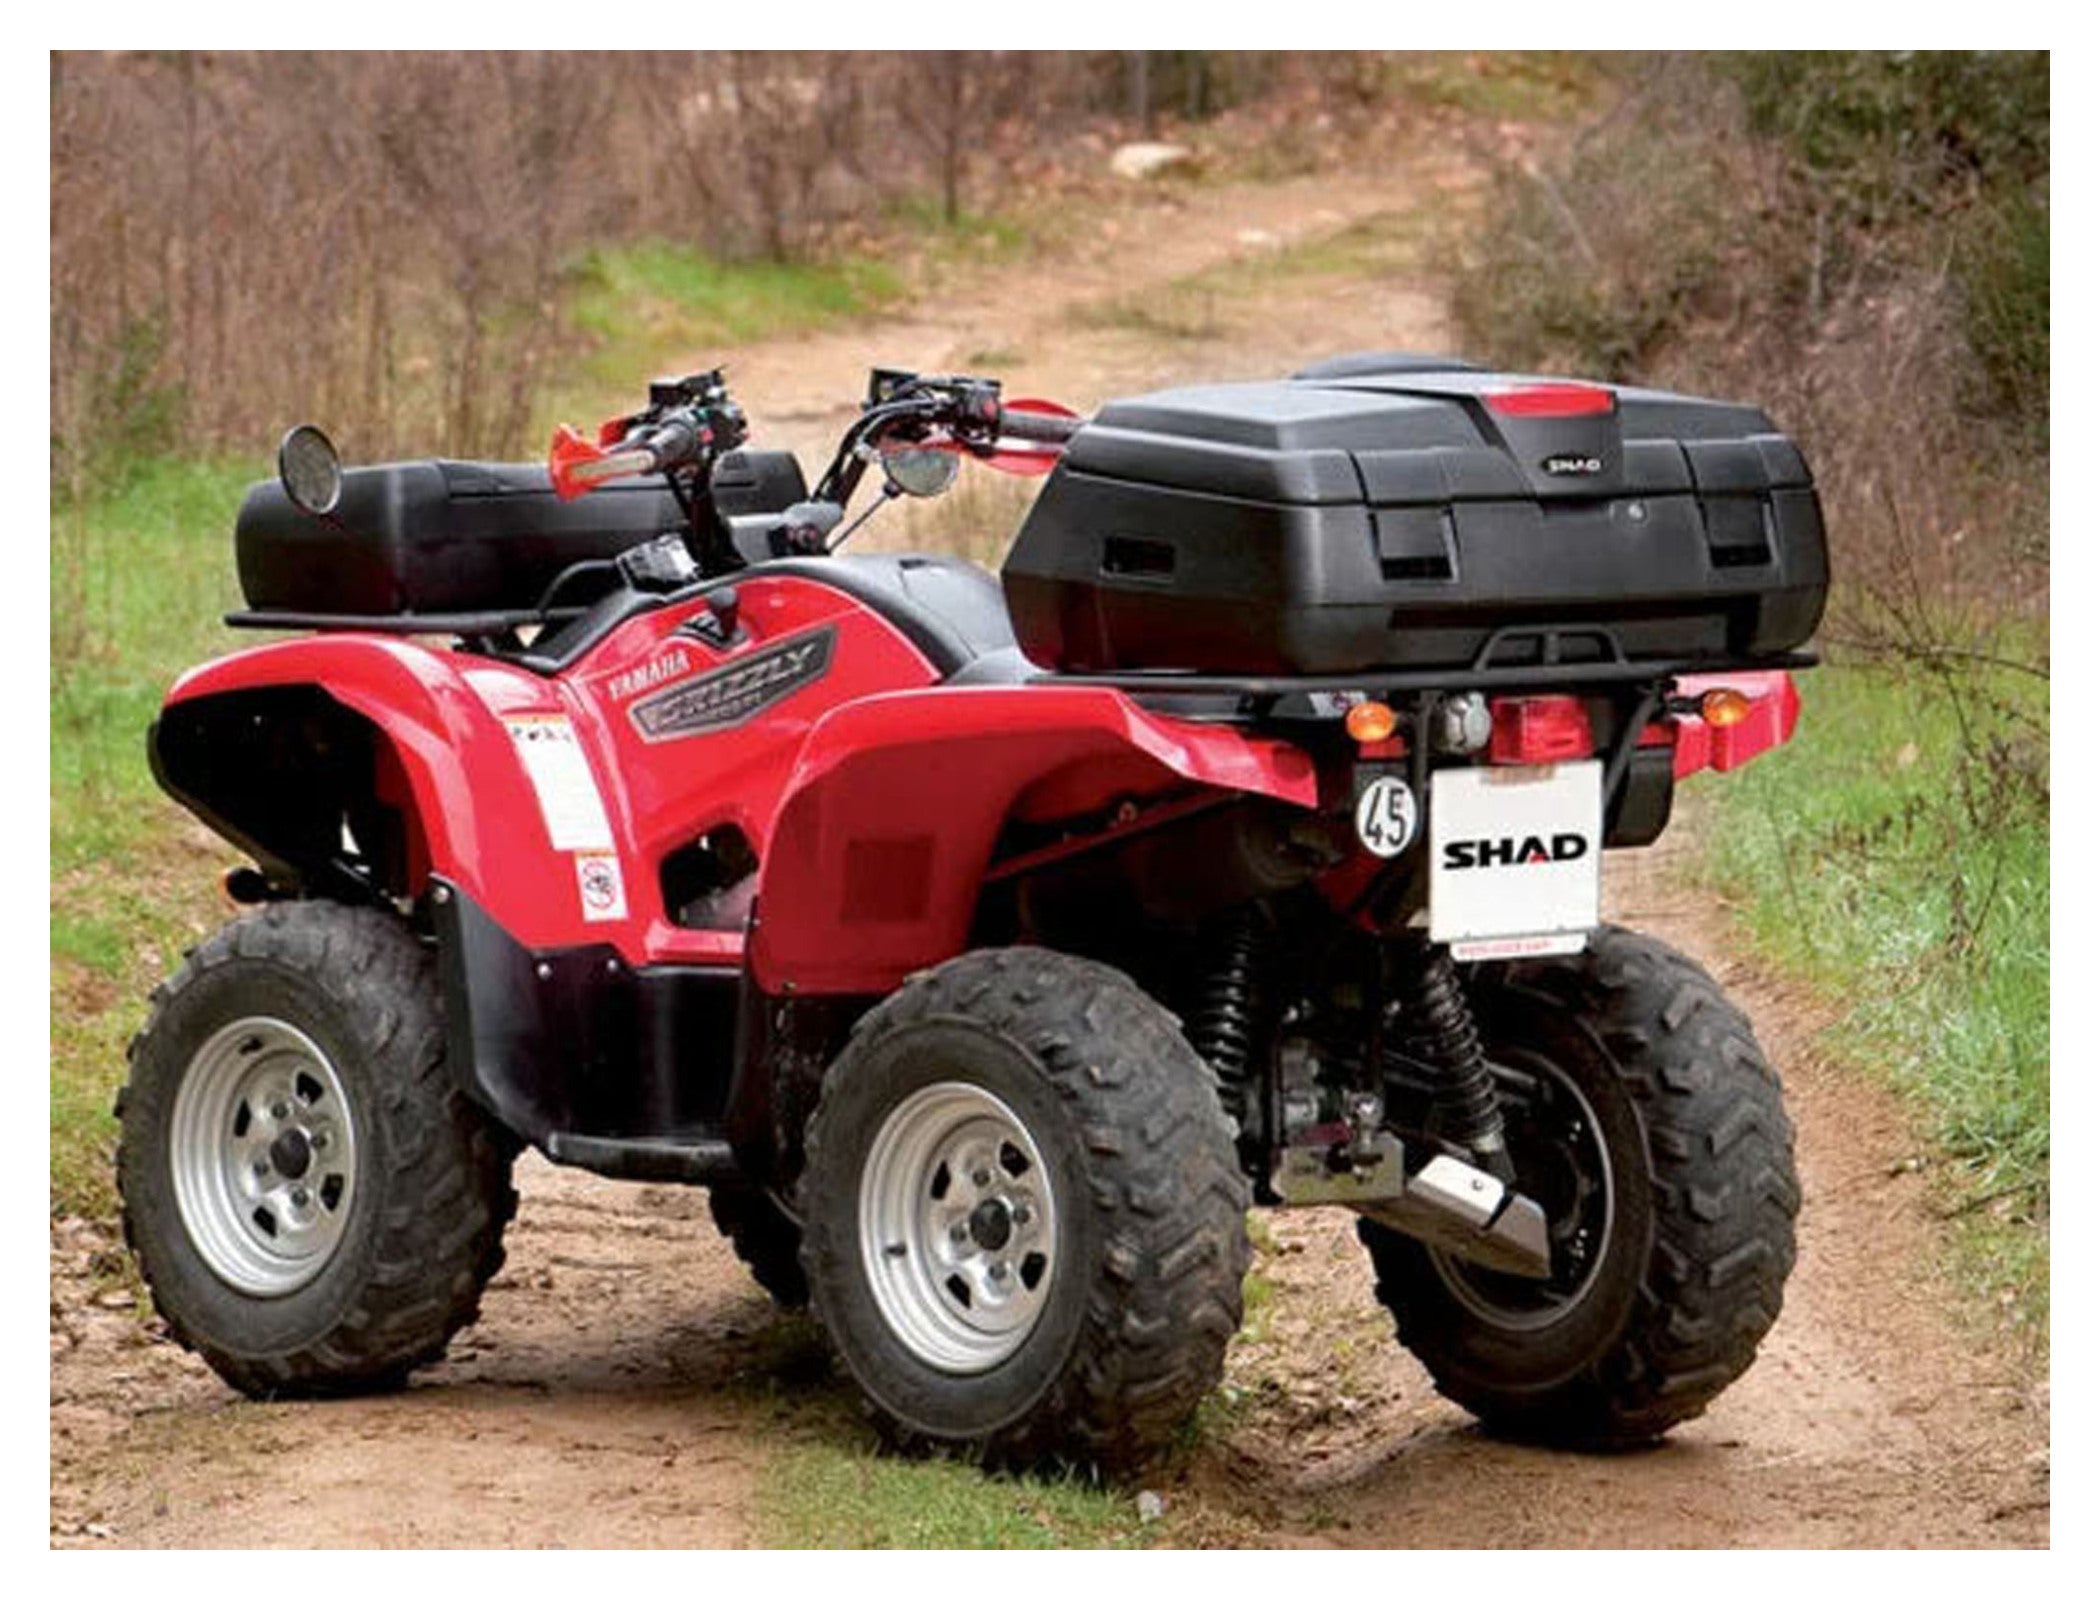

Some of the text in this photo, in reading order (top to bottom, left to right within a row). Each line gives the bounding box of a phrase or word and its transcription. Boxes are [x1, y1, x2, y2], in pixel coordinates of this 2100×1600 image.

[608, 649, 690, 700] YAMAHA
[1364, 786, 1407, 847] 45
[1443, 832, 1588, 870] SHAD
